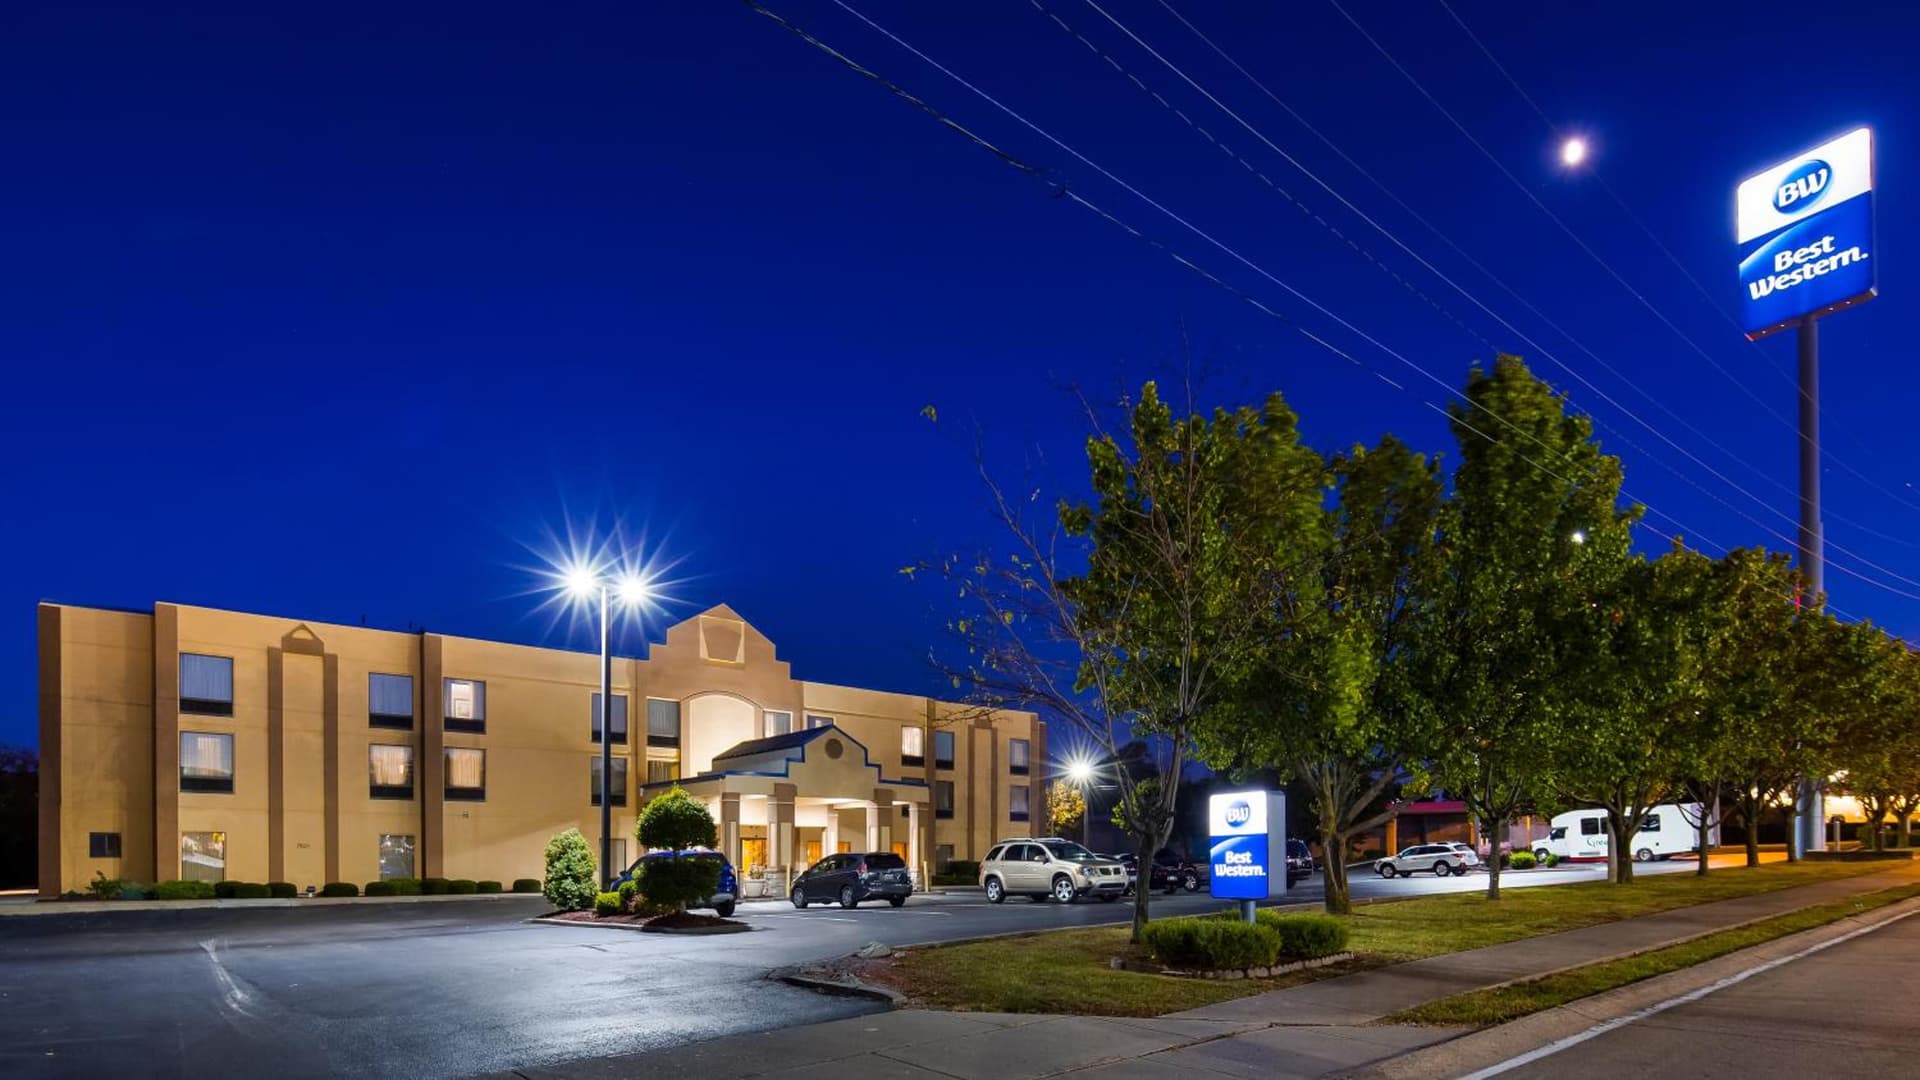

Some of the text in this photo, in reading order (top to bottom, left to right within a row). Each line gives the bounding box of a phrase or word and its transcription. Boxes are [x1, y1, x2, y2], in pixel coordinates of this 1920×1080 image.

[1778, 168, 1828, 208] BW
[1774, 235, 1835, 272] Best
[1749, 246, 1869, 300] Western.
[1228, 808, 1248, 822] BW
[1226, 851, 1252, 863] Best
[1215, 864, 1266, 876] Western.
